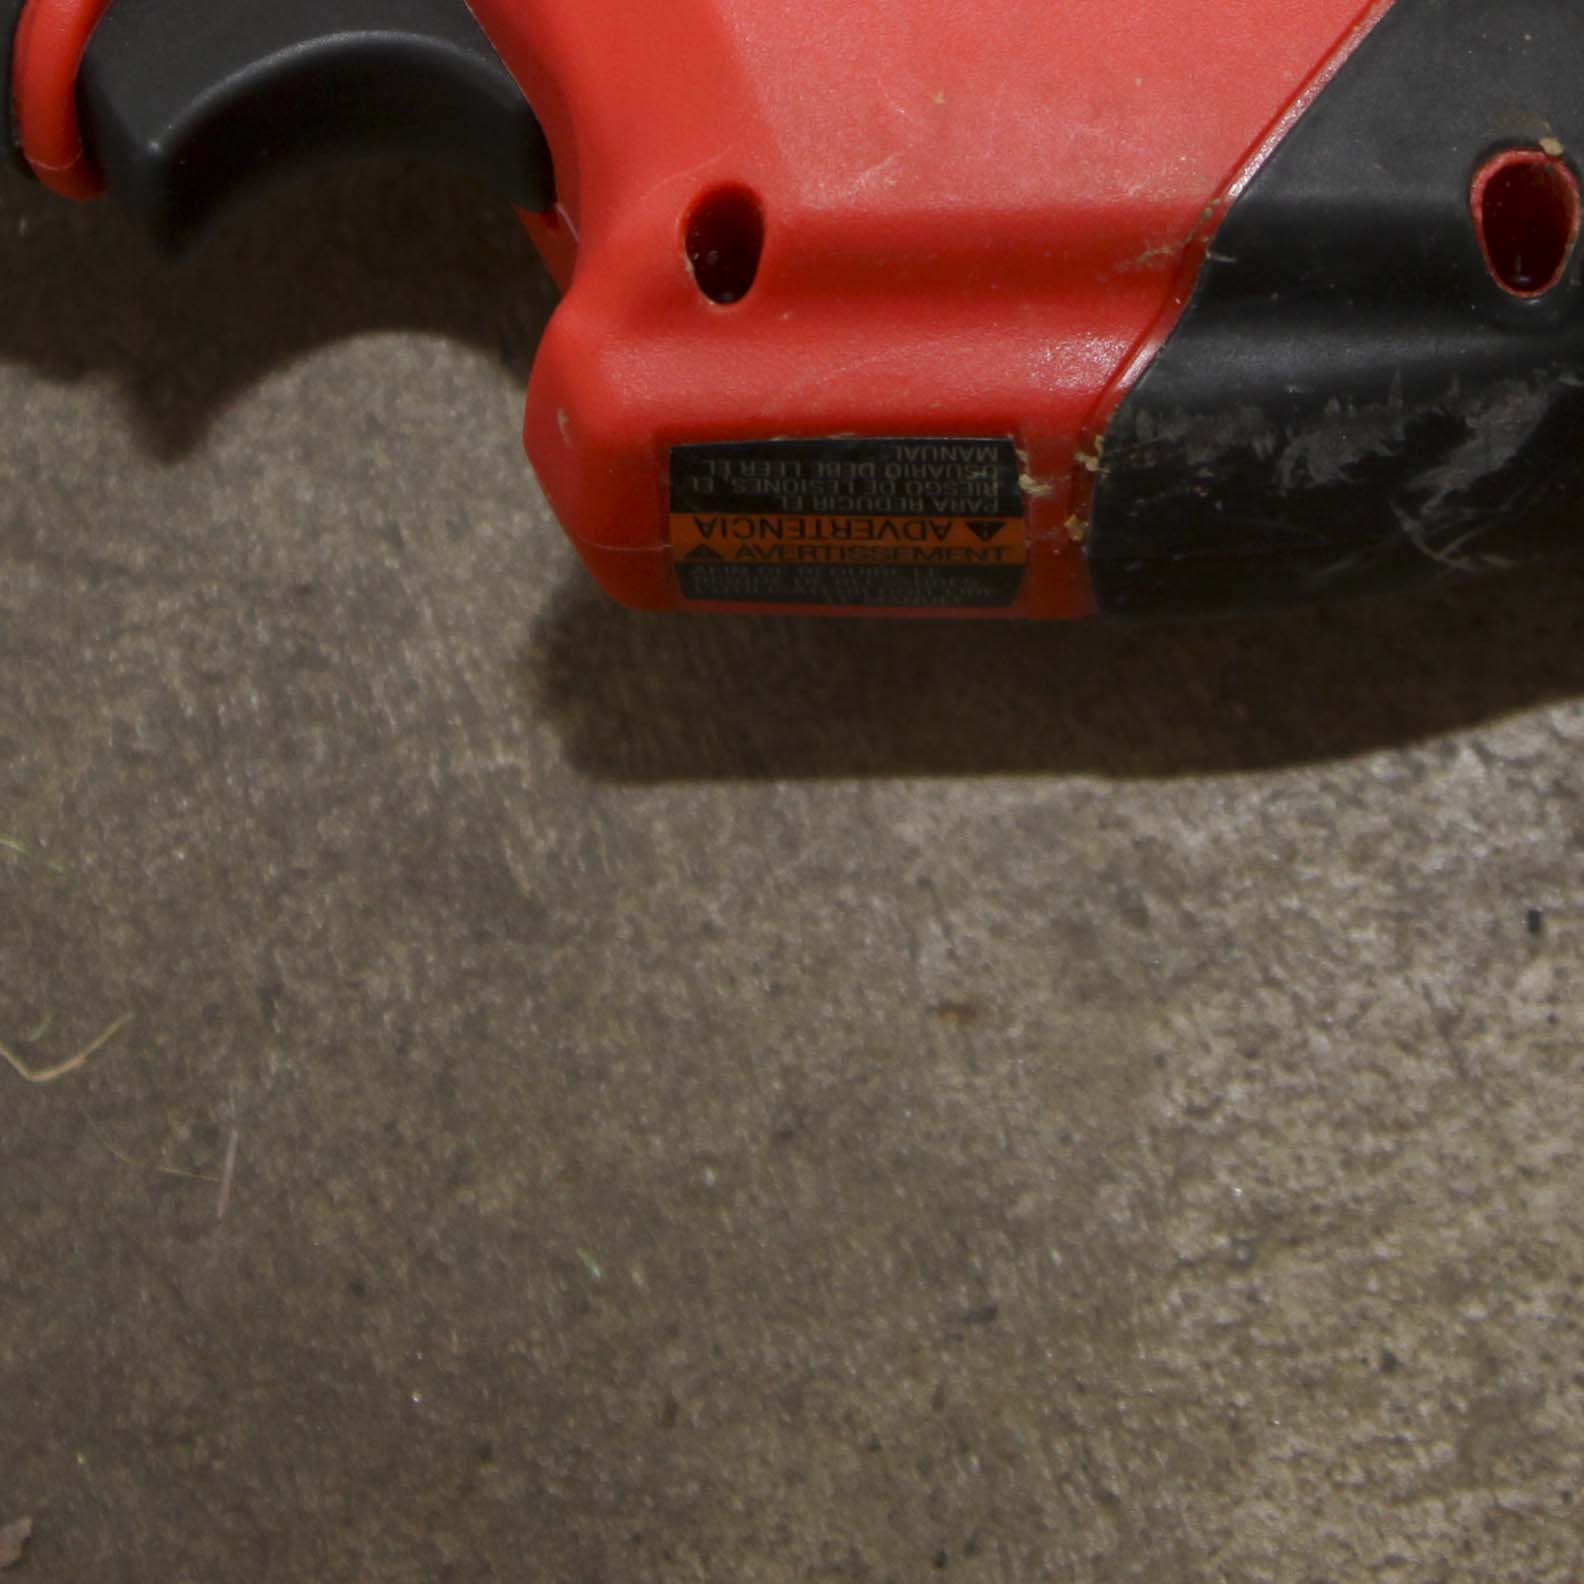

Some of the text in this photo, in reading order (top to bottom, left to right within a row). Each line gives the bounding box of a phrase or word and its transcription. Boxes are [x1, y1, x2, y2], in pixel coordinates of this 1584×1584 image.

[740, 461, 801, 478] LEER
[816, 461, 876, 478] DEBE
[885, 463, 998, 480] USUARIO
[871, 479, 896, 496] DE
[904, 480, 1000, 497] RIESGO
[812, 495, 924, 512] REDUCIR
[935, 497, 999, 513] PARA
[692, 516, 953, 541] ADVERTENCIA
